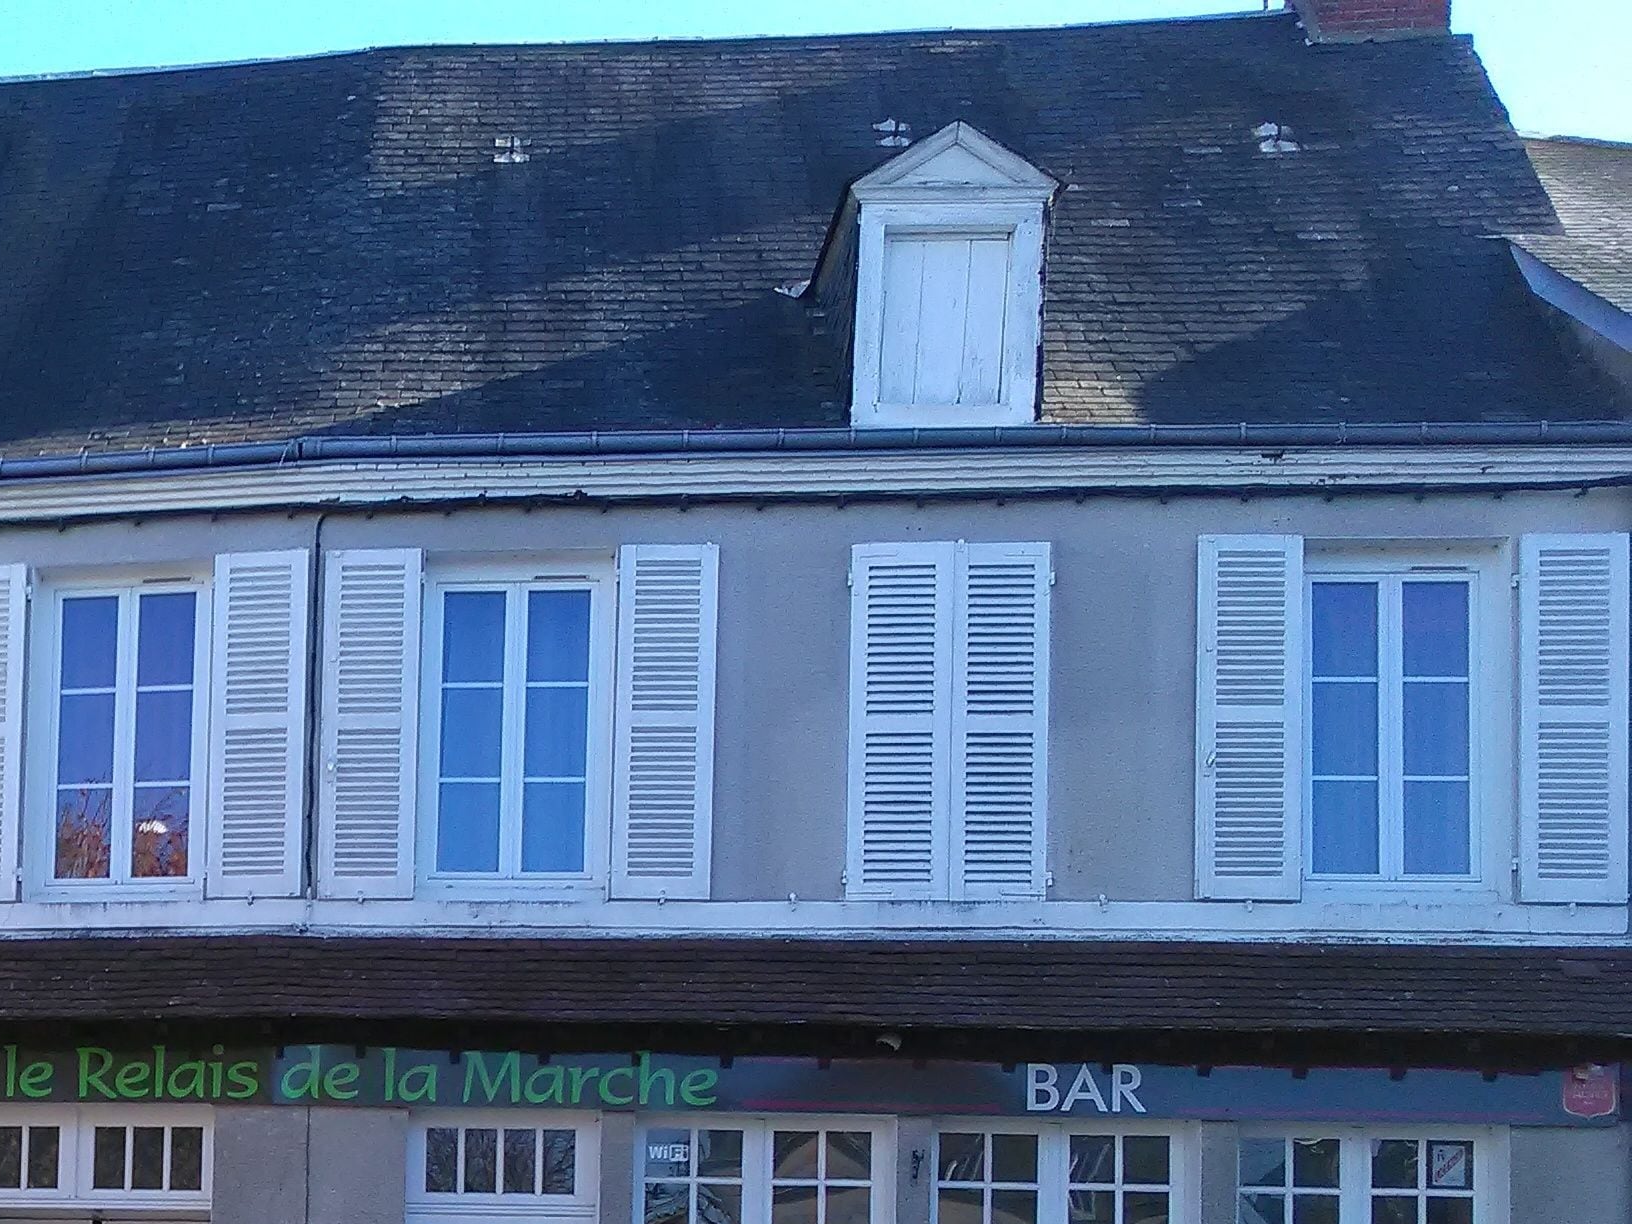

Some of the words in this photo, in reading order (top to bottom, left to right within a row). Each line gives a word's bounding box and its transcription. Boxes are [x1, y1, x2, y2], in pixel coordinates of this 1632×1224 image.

[3, 1045, 54, 1098] le
[76, 1044, 258, 1099] Relais
[280, 1046, 360, 1099] de
[381, 1047, 438, 1102] la
[462, 1050, 719, 1105] Marche
[1026, 1062, 1147, 1113] BAR
